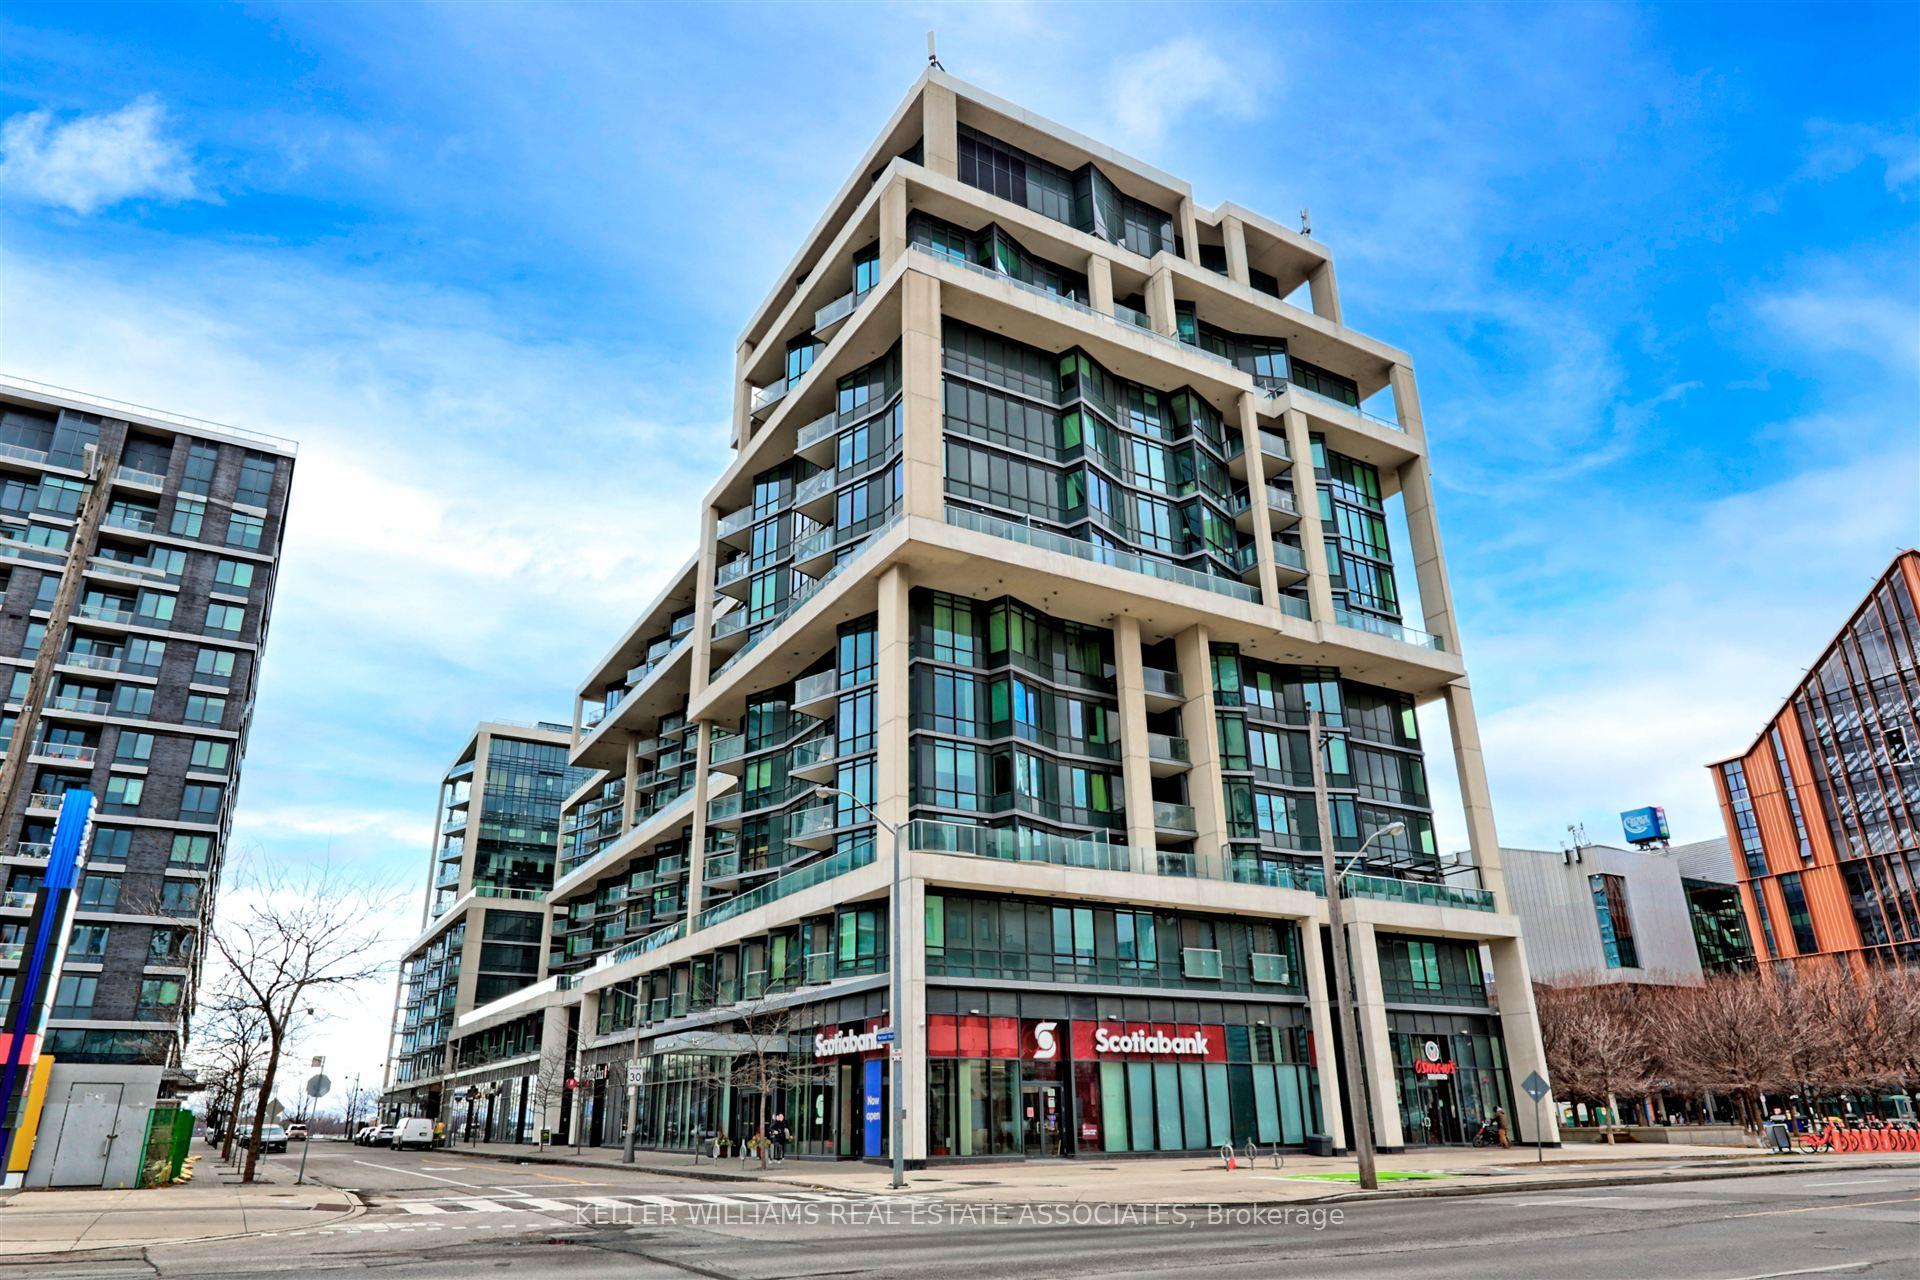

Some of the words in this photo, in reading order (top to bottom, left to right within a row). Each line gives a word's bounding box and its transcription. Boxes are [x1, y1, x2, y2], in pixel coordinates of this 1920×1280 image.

[815, 1025, 884, 1057] Scotiabank
[1095, 1028, 1209, 1054] Scotiabank
[629, 1073, 641, 1082] 30
[867, 1095, 880, 1105] Now
[866, 1112, 880, 1123] open
